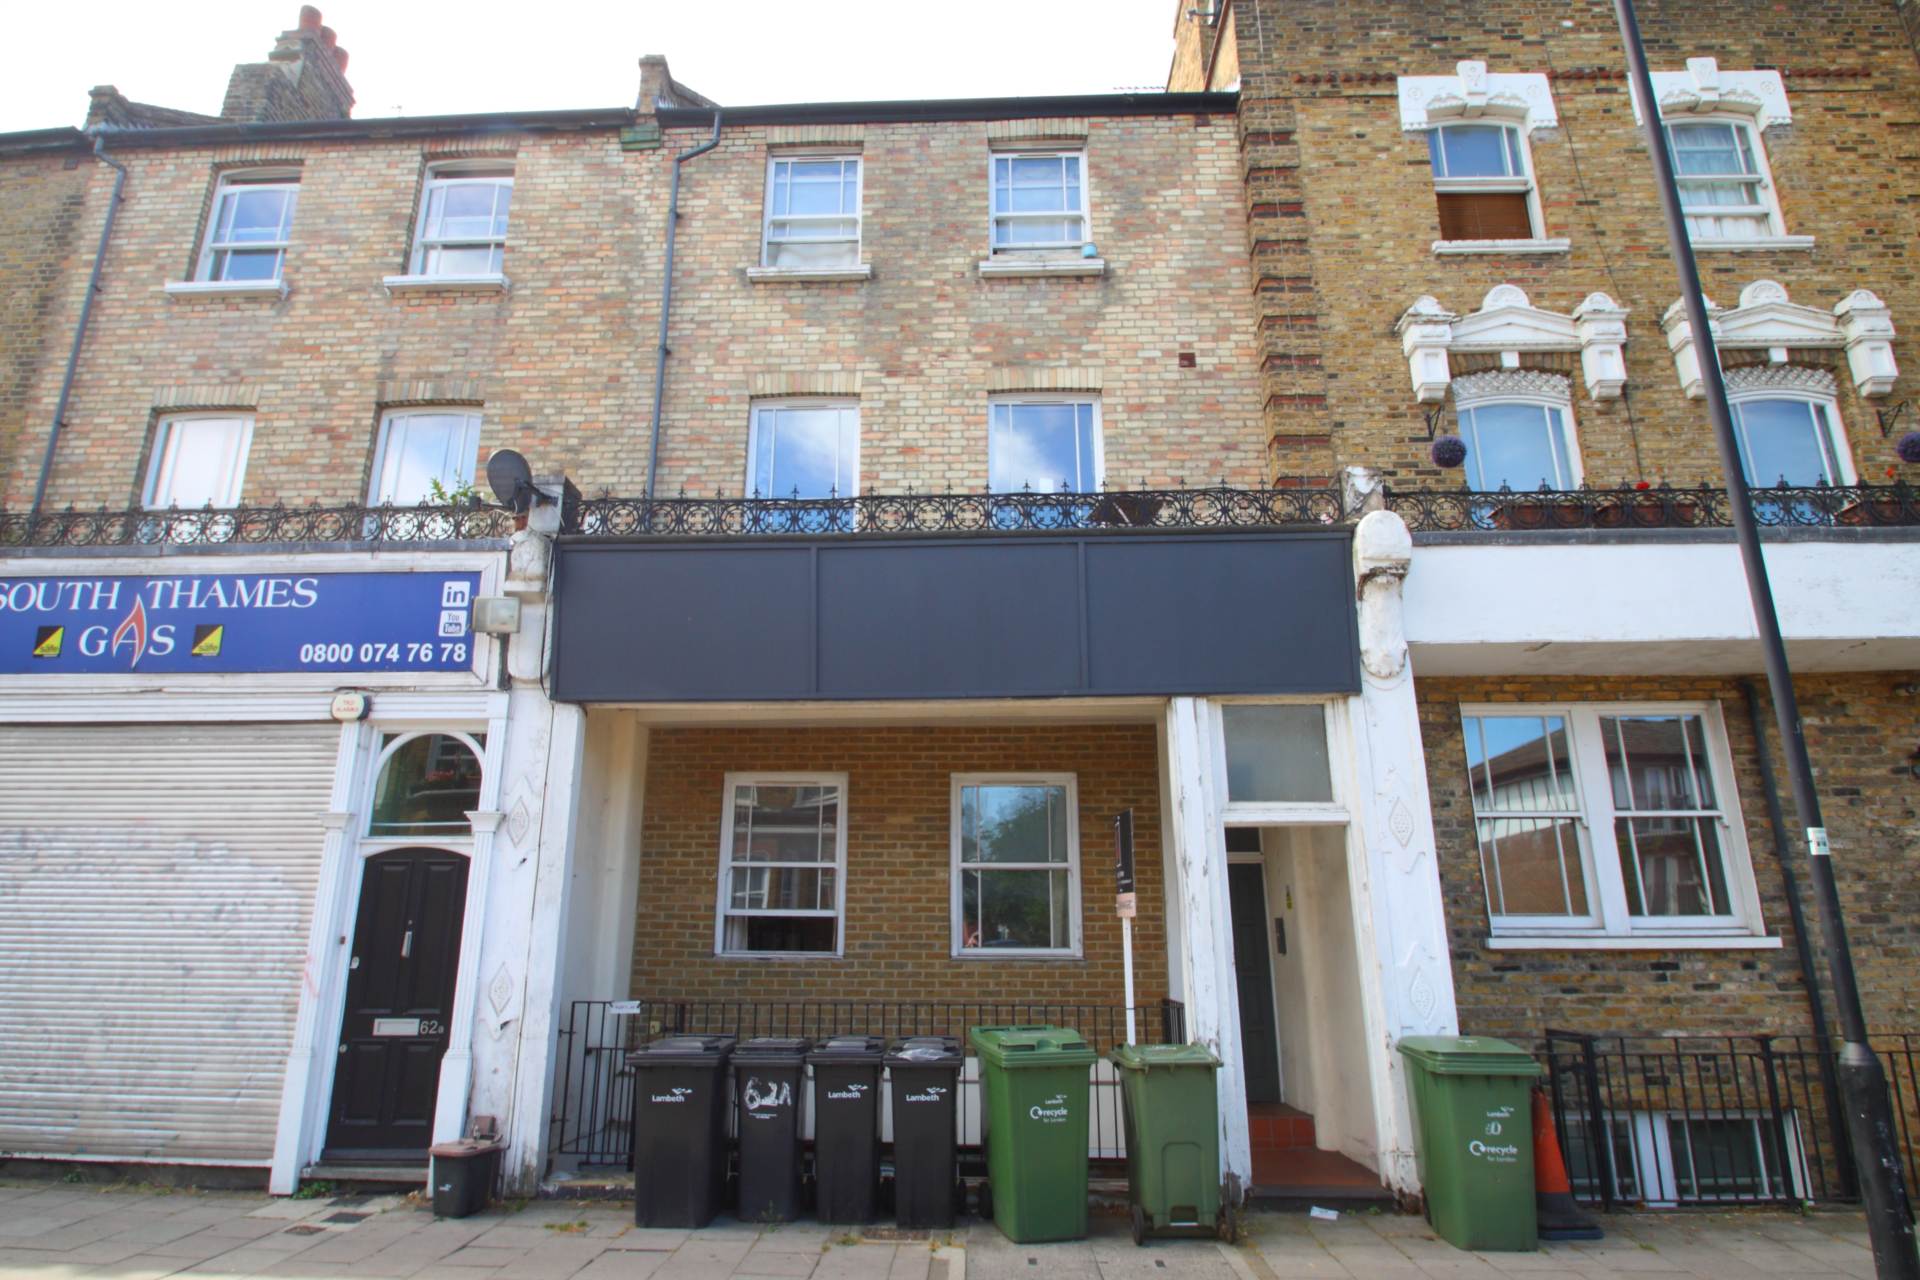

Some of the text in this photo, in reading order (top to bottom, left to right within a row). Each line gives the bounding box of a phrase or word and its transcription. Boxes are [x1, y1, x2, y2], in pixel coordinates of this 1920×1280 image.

[146, 578, 319, 608] THAMES
[445, 586, 466, 603] in
[447, 613, 460, 622] You
[79, 593, 176, 668] GAS
[300, 643, 467, 663] 0800 074 76 78
[652, 1094, 685, 1102] Lambeth
[828, 1091, 861, 1099] Lambeth
[906, 1094, 940, 1102] Lambeth
[1042, 1107, 1068, 1117] recycle
[1487, 1144, 1518, 1155] recycle
